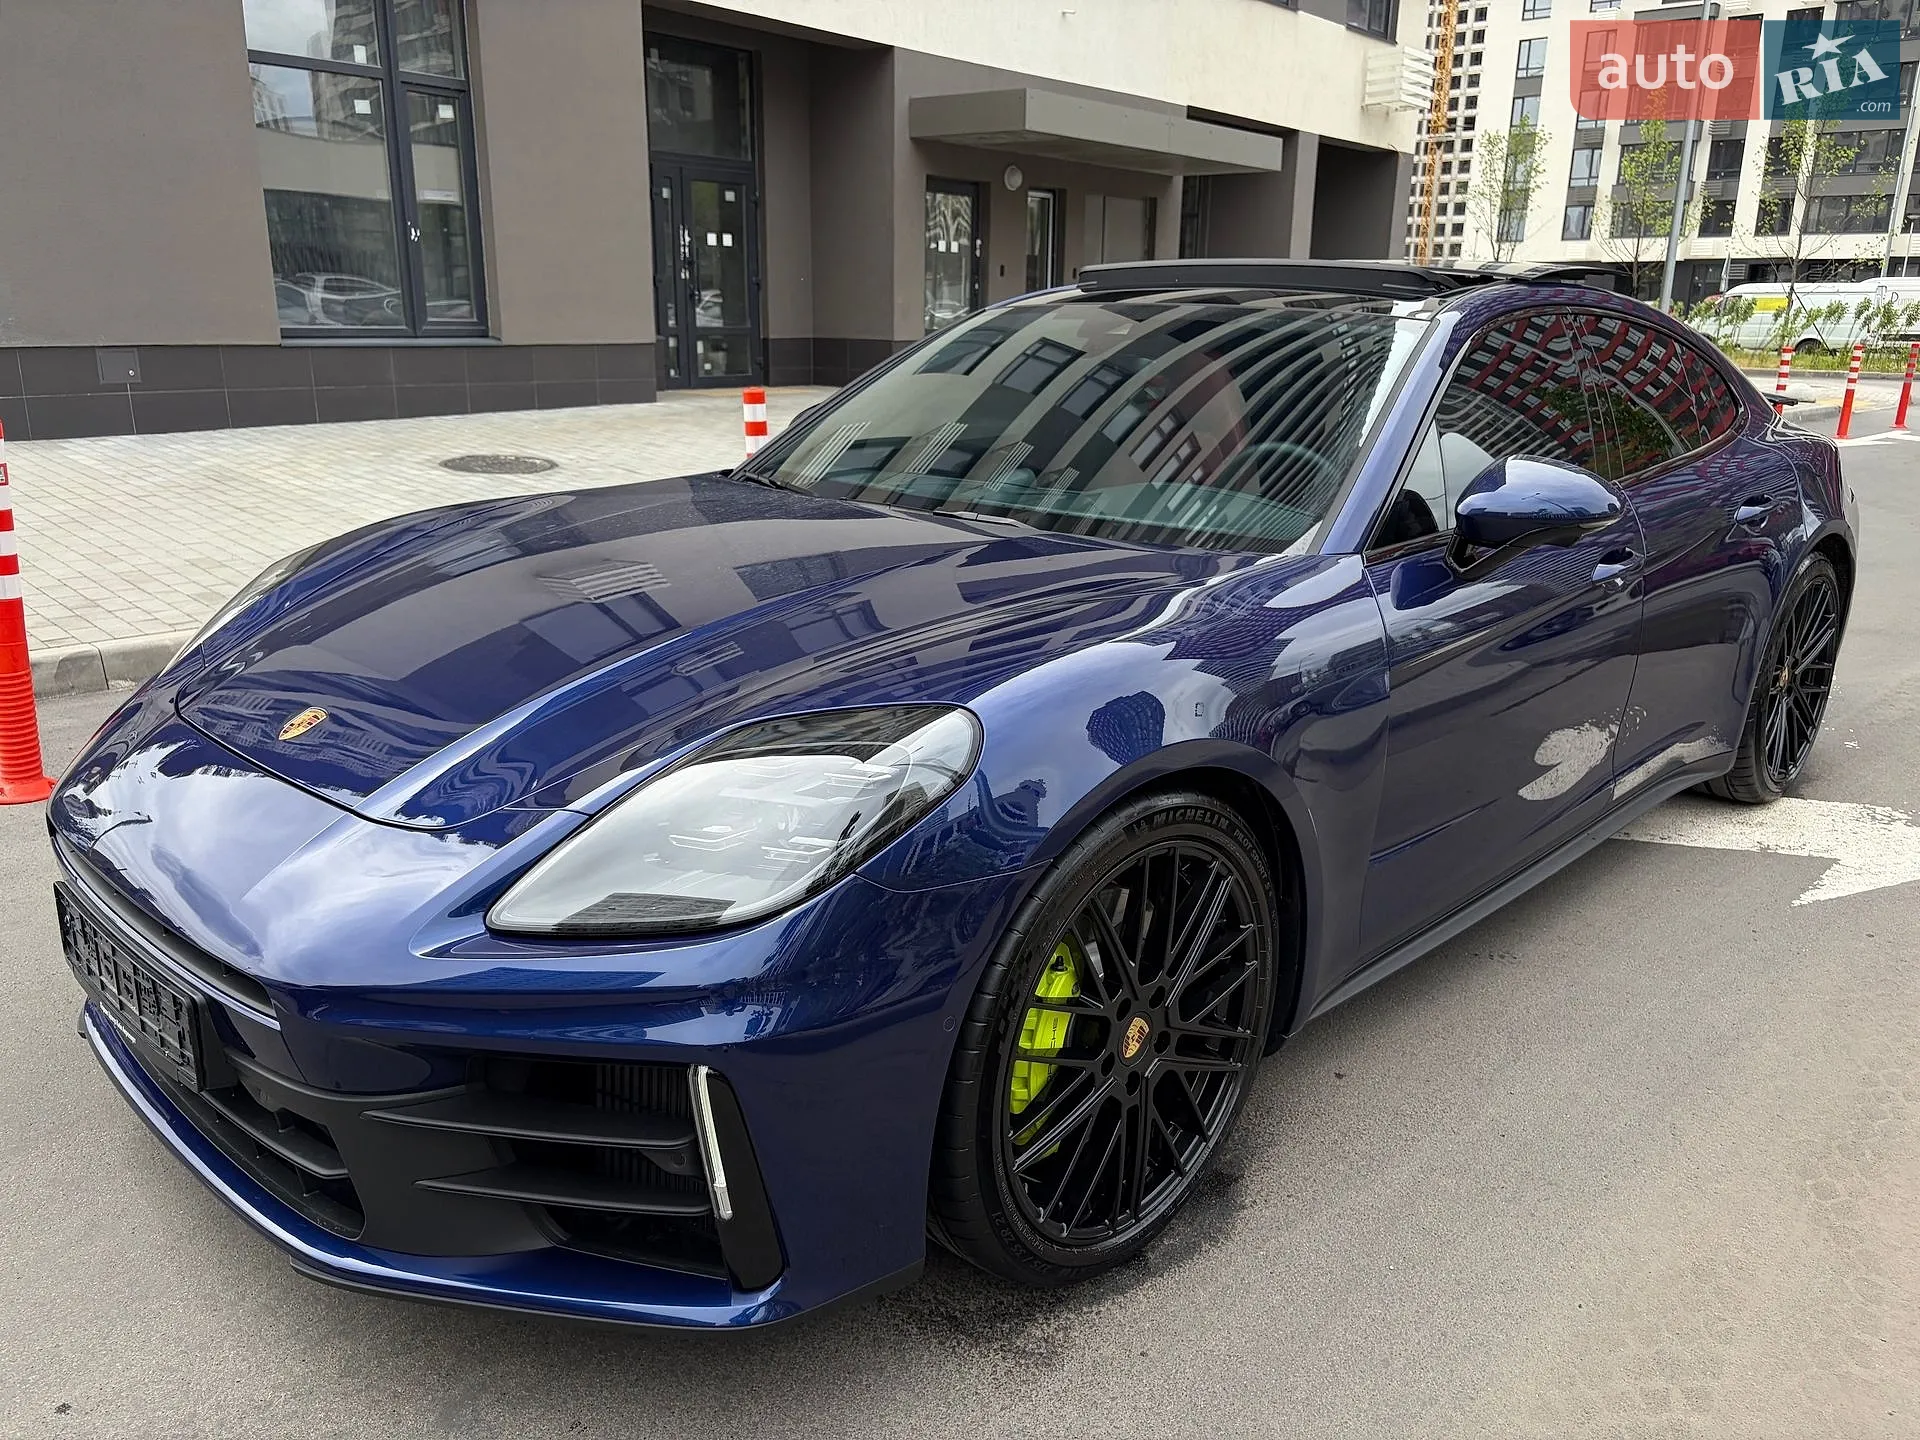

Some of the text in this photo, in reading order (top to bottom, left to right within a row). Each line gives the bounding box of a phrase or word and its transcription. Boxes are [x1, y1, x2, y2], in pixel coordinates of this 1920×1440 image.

[1153, 808, 1229, 829] MICHELIN
[1234, 829, 1253, 851] PILOT
[1250, 849, 1268, 879] SPORT
